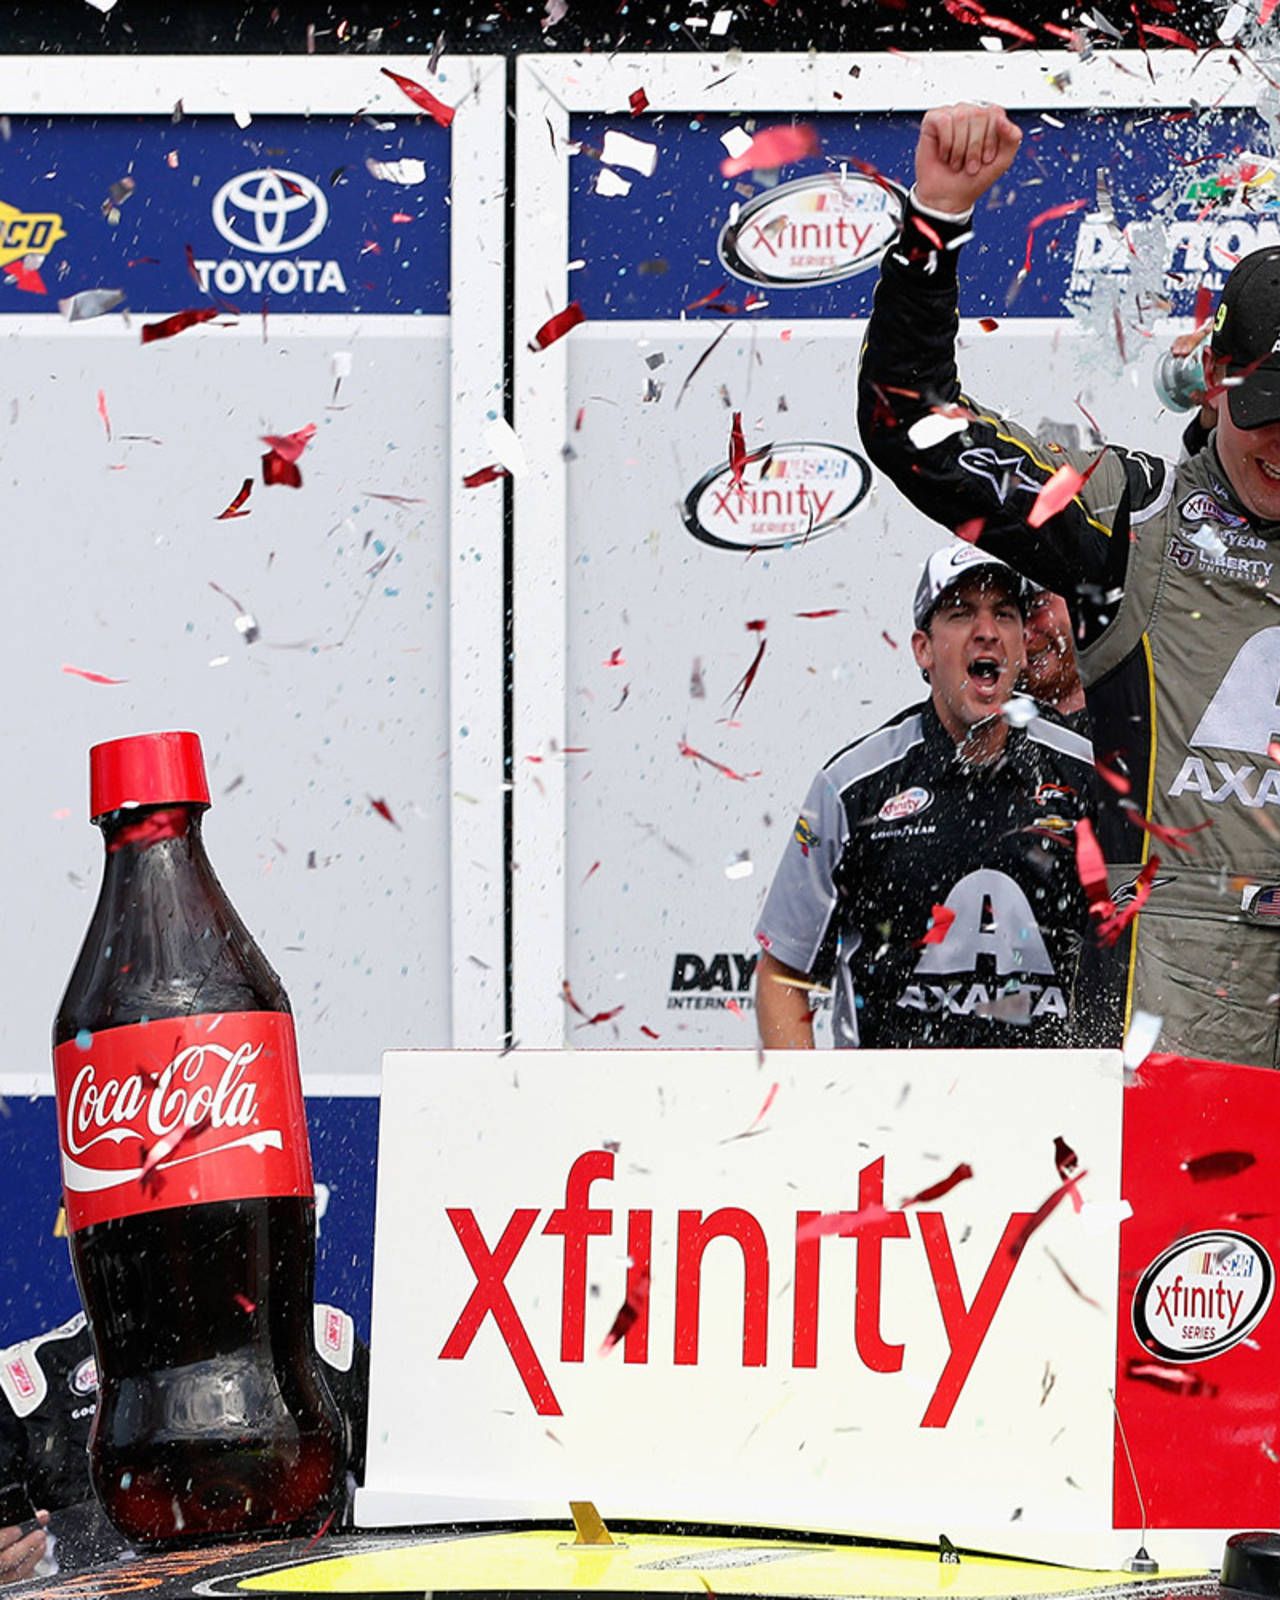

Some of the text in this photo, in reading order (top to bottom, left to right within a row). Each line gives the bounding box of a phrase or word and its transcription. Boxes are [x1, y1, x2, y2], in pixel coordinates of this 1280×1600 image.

[0, 221, 53, 248] CO
[196, 260, 346, 294] TOYOTA
[713, 483, 834, 525] xfinity
[870, 825, 937, 840] GOODYEAR
[66, 1041, 265, 1156] Coca-Cola
[438, 1150, 1035, 1428] xfinity
[1155, 1275, 1244, 1330] xfinity
[1182, 1325, 1216, 1340] SERIES
[942, 1552, 958, 1565] 66
